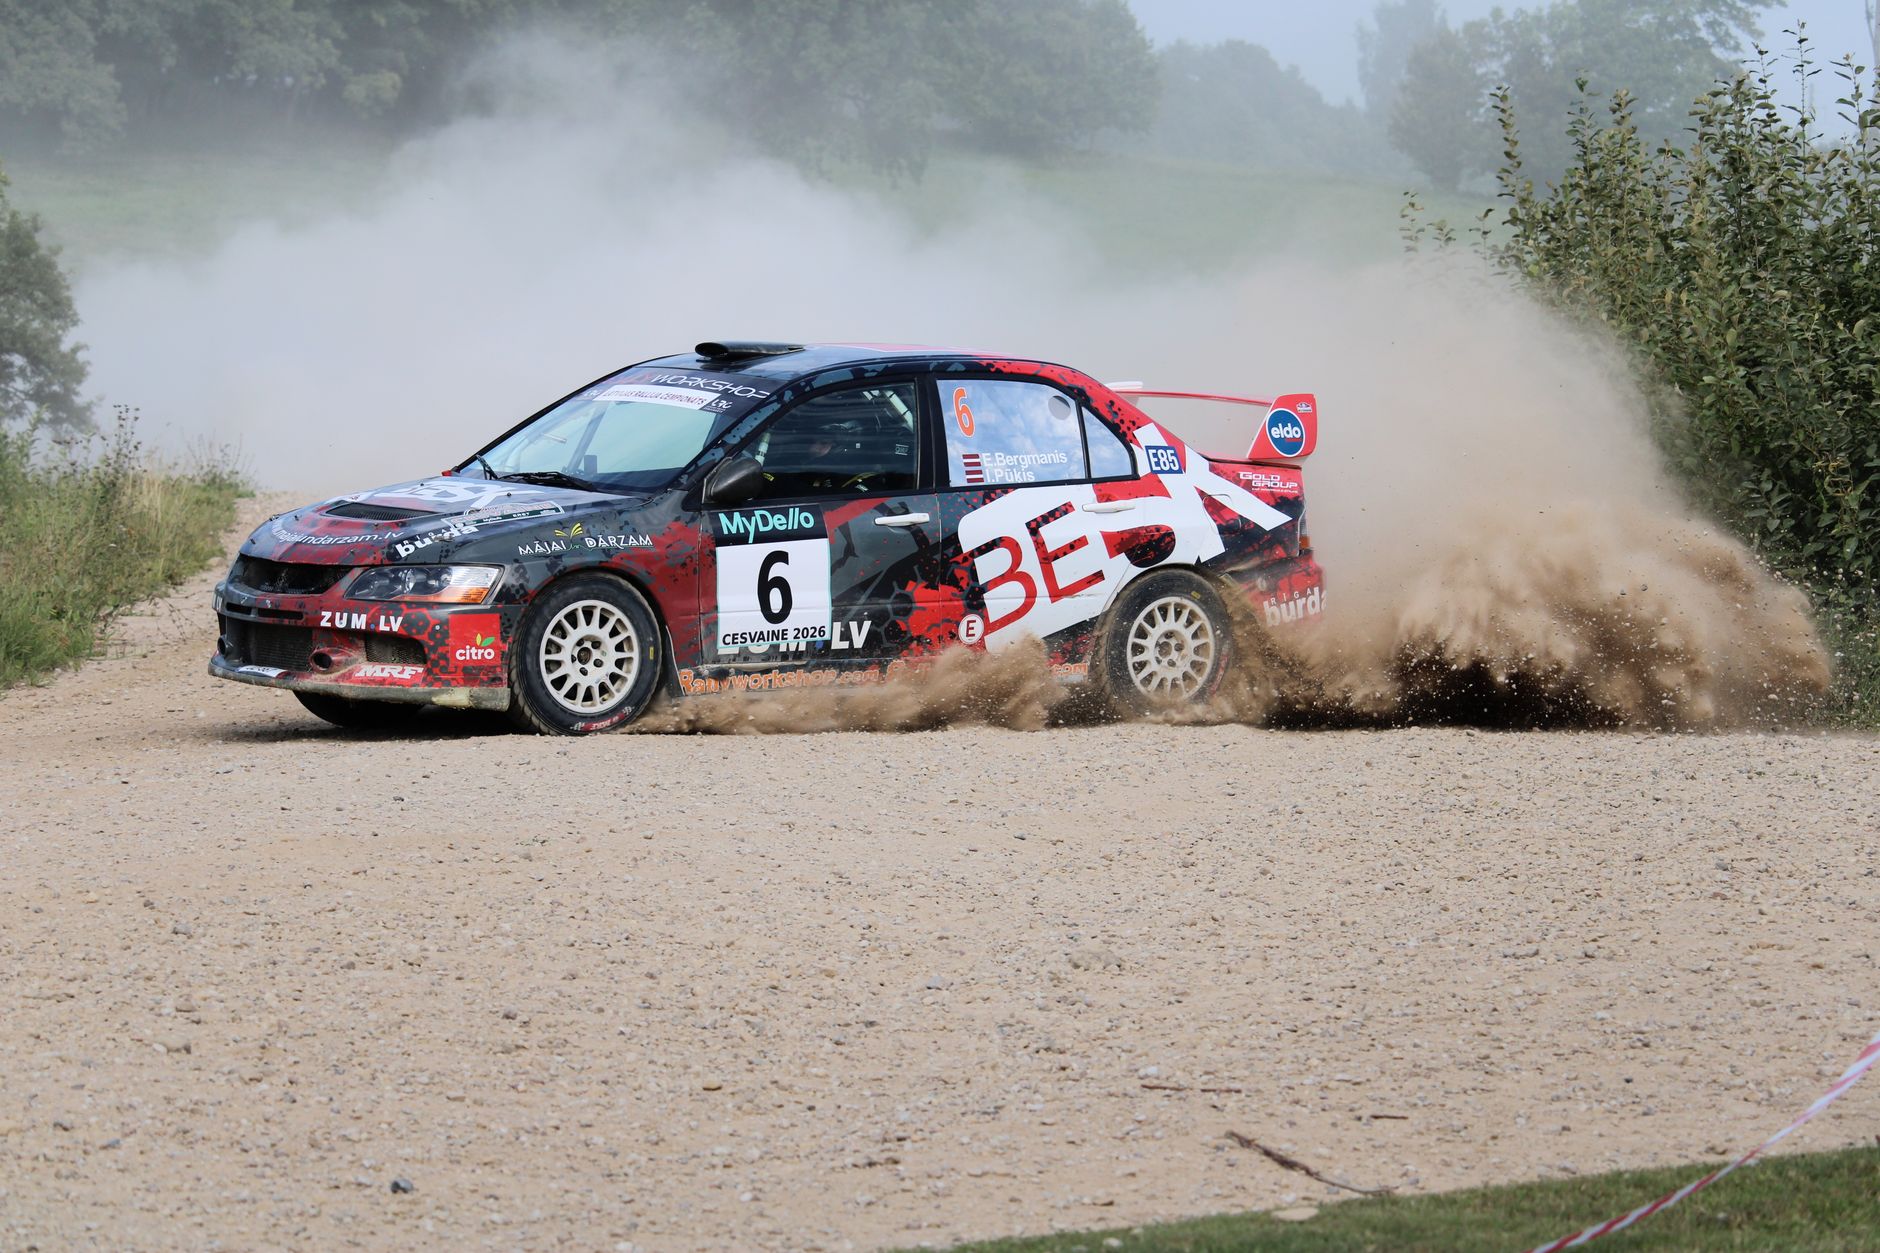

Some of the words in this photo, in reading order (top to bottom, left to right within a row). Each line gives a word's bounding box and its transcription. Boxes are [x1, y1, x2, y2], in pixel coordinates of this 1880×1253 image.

[953, 387, 976, 438] 6
[1270, 422, 1302, 439] eldo
[982, 450, 1068, 469] E.Bergmanis
[1147, 449, 1180, 472] E85
[1238, 471, 1281, 481] GOLD
[1251, 480, 1298, 489] GROUP
[718, 507, 815, 544] MyDello
[517, 540, 567, 556] MĀJAI
[584, 534, 653, 550] DĀRZAM
[757, 549, 793, 625] 6
[1270, 587, 1312, 606] RIGA
[721, 629, 789, 646] CESVAINE
[793, 625, 826, 640] 2026
[455, 645, 496, 661] citro
[354, 664, 425, 680] MRF
